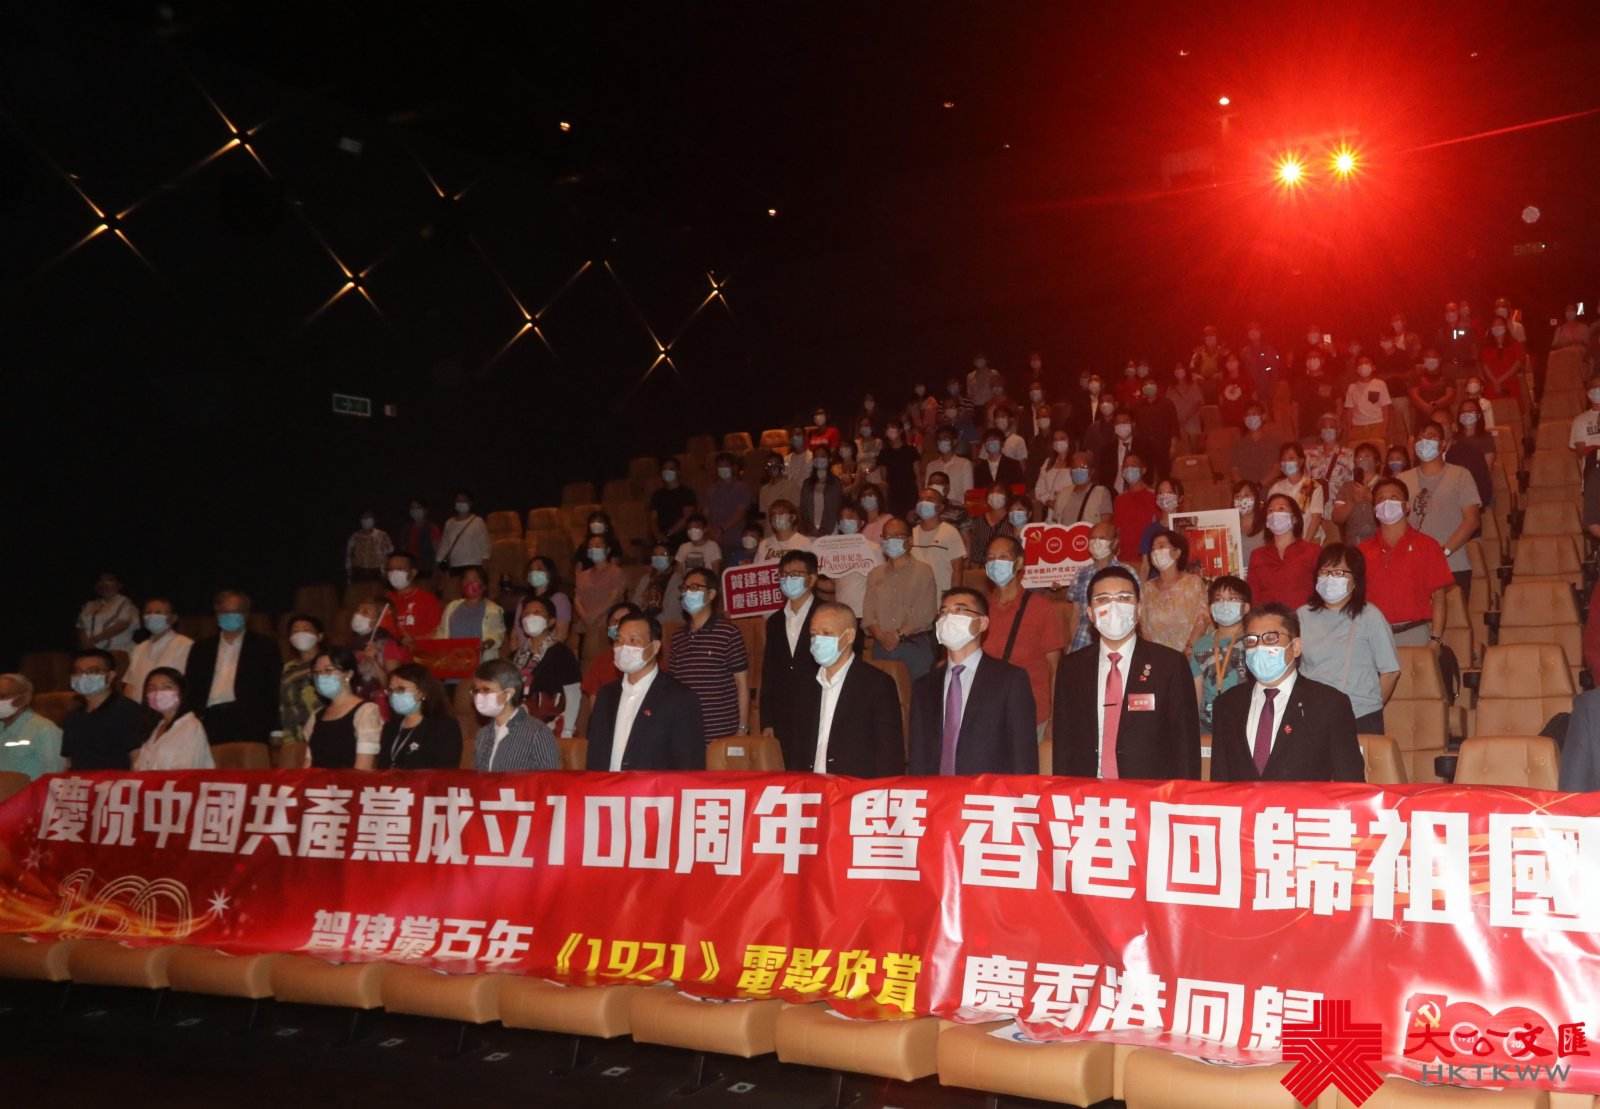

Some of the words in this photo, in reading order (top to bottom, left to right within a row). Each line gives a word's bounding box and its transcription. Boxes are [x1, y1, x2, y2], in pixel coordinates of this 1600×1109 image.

[37, 777, 822, 876] 慶祝中國共產黨成立100周年
[846, 788, 928, 881] 暨
[959, 793, 1600, 932] 香港回歸祖國
